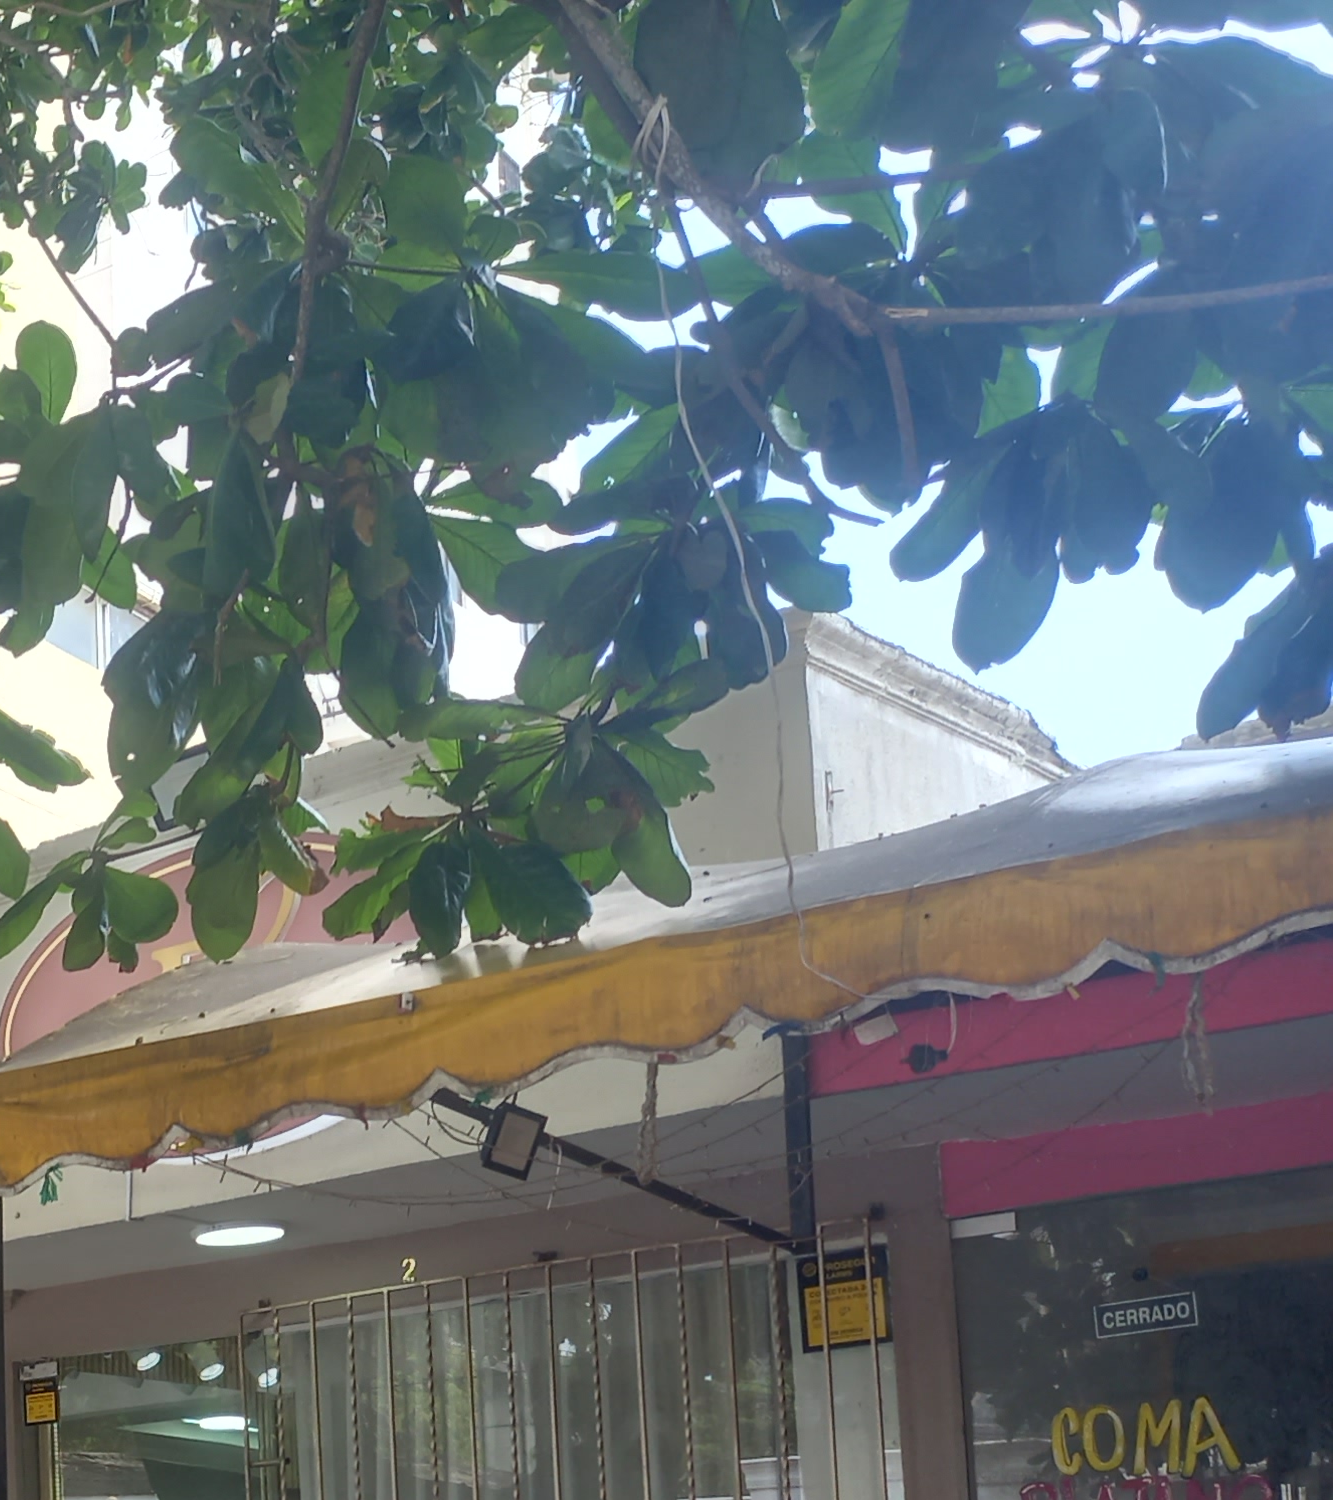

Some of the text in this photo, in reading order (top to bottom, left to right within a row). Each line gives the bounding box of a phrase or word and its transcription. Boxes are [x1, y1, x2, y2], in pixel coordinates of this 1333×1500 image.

[401, 1257, 416, 1283] 2
[1101, 1301, 1191, 1330] CERRADO
[1051, 1396, 1241, 1478] COMA
